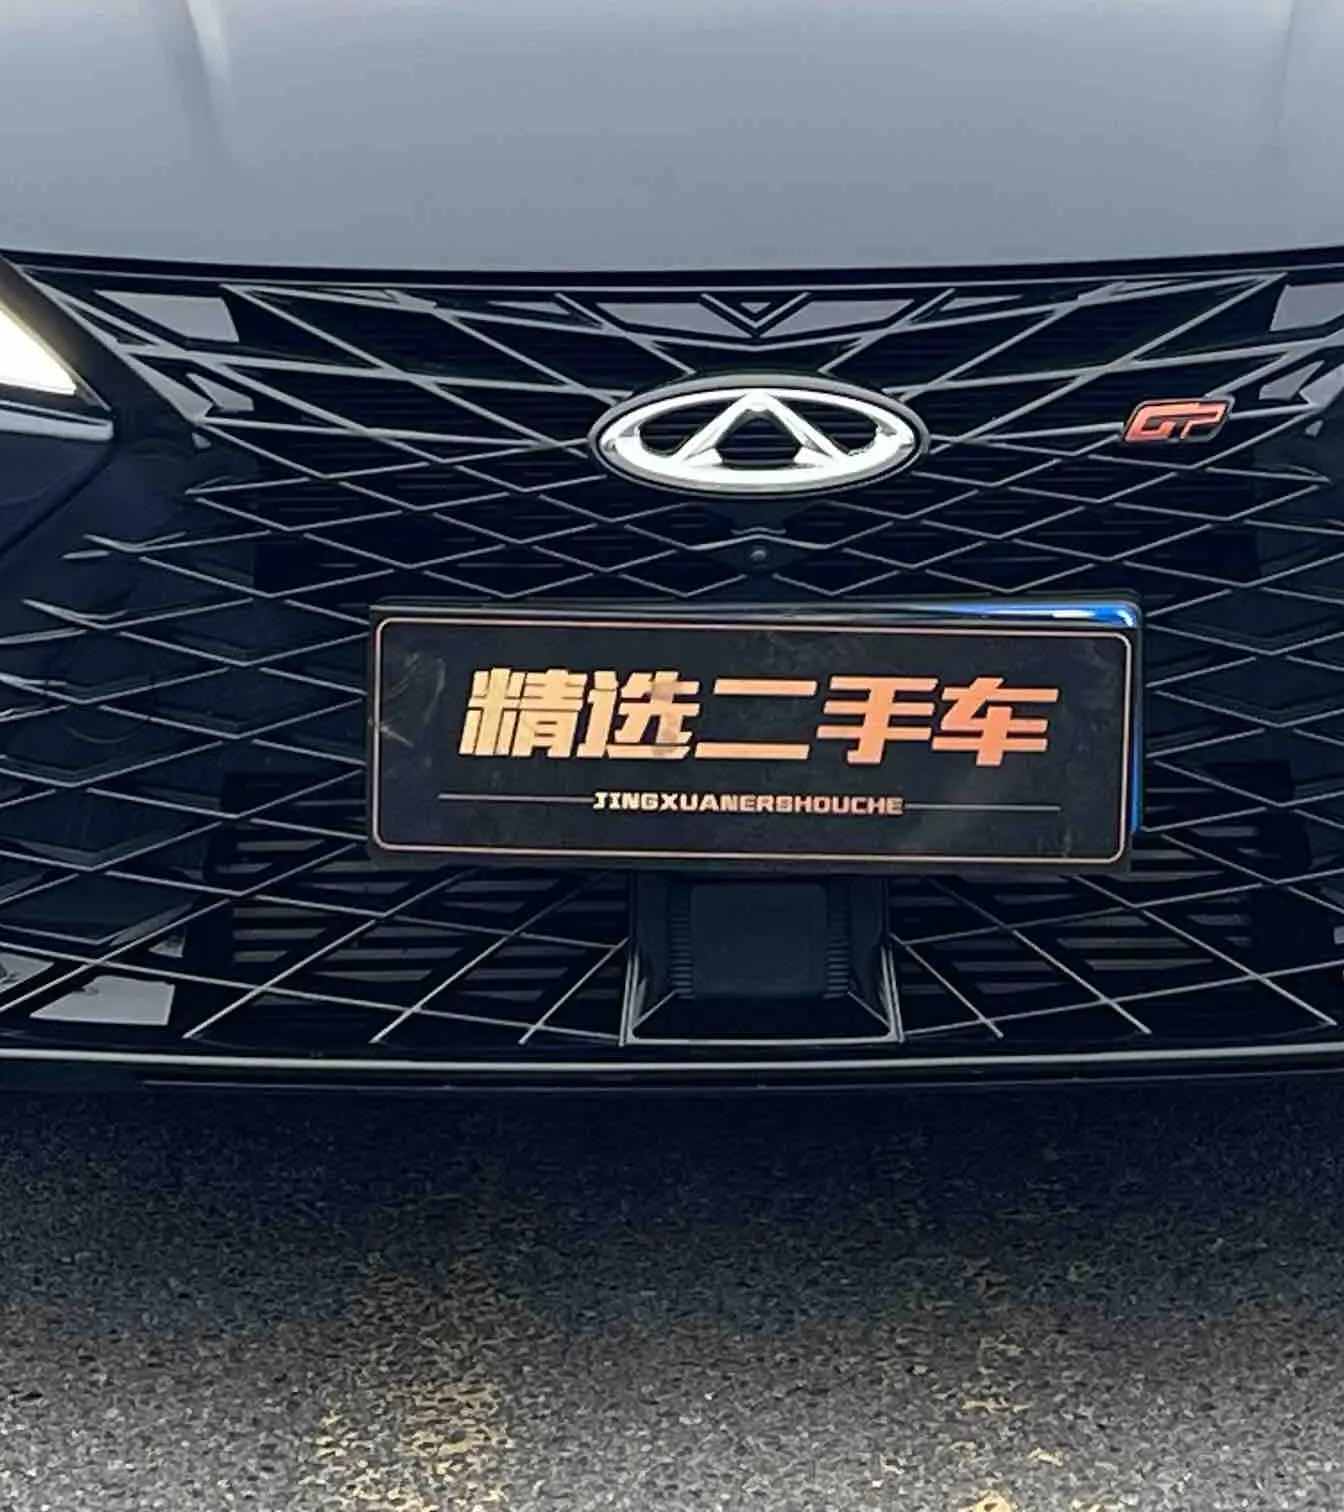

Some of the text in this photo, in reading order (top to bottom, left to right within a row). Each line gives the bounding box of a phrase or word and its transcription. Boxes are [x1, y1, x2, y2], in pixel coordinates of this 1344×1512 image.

[458, 667, 1059, 766] 精选二手车
[592, 791, 904, 815] JINGXUANERSHOUCHE
